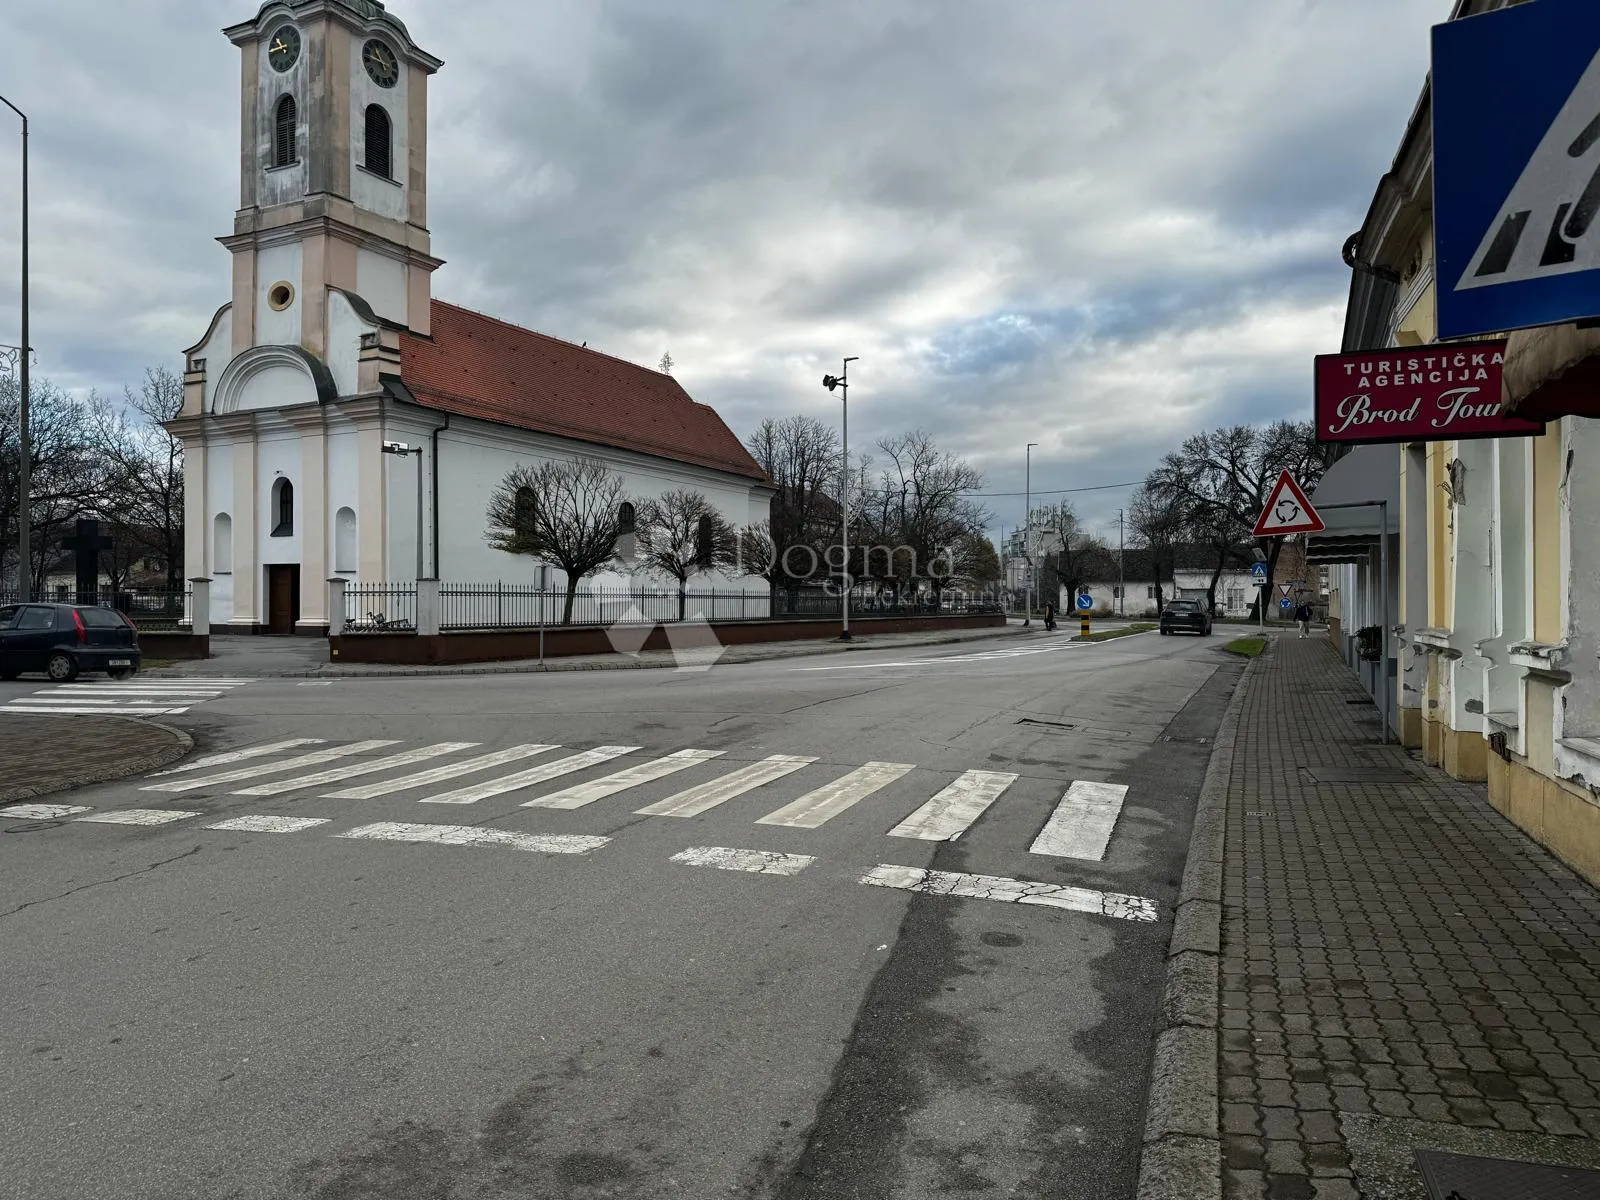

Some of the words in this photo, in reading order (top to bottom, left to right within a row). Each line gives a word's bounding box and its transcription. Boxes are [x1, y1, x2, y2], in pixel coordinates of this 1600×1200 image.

[1344, 353, 1503, 375] TURISTIČKA
[1358, 368, 1488, 388] AGENCIJA
[1328, 392, 1422, 434] Brod
